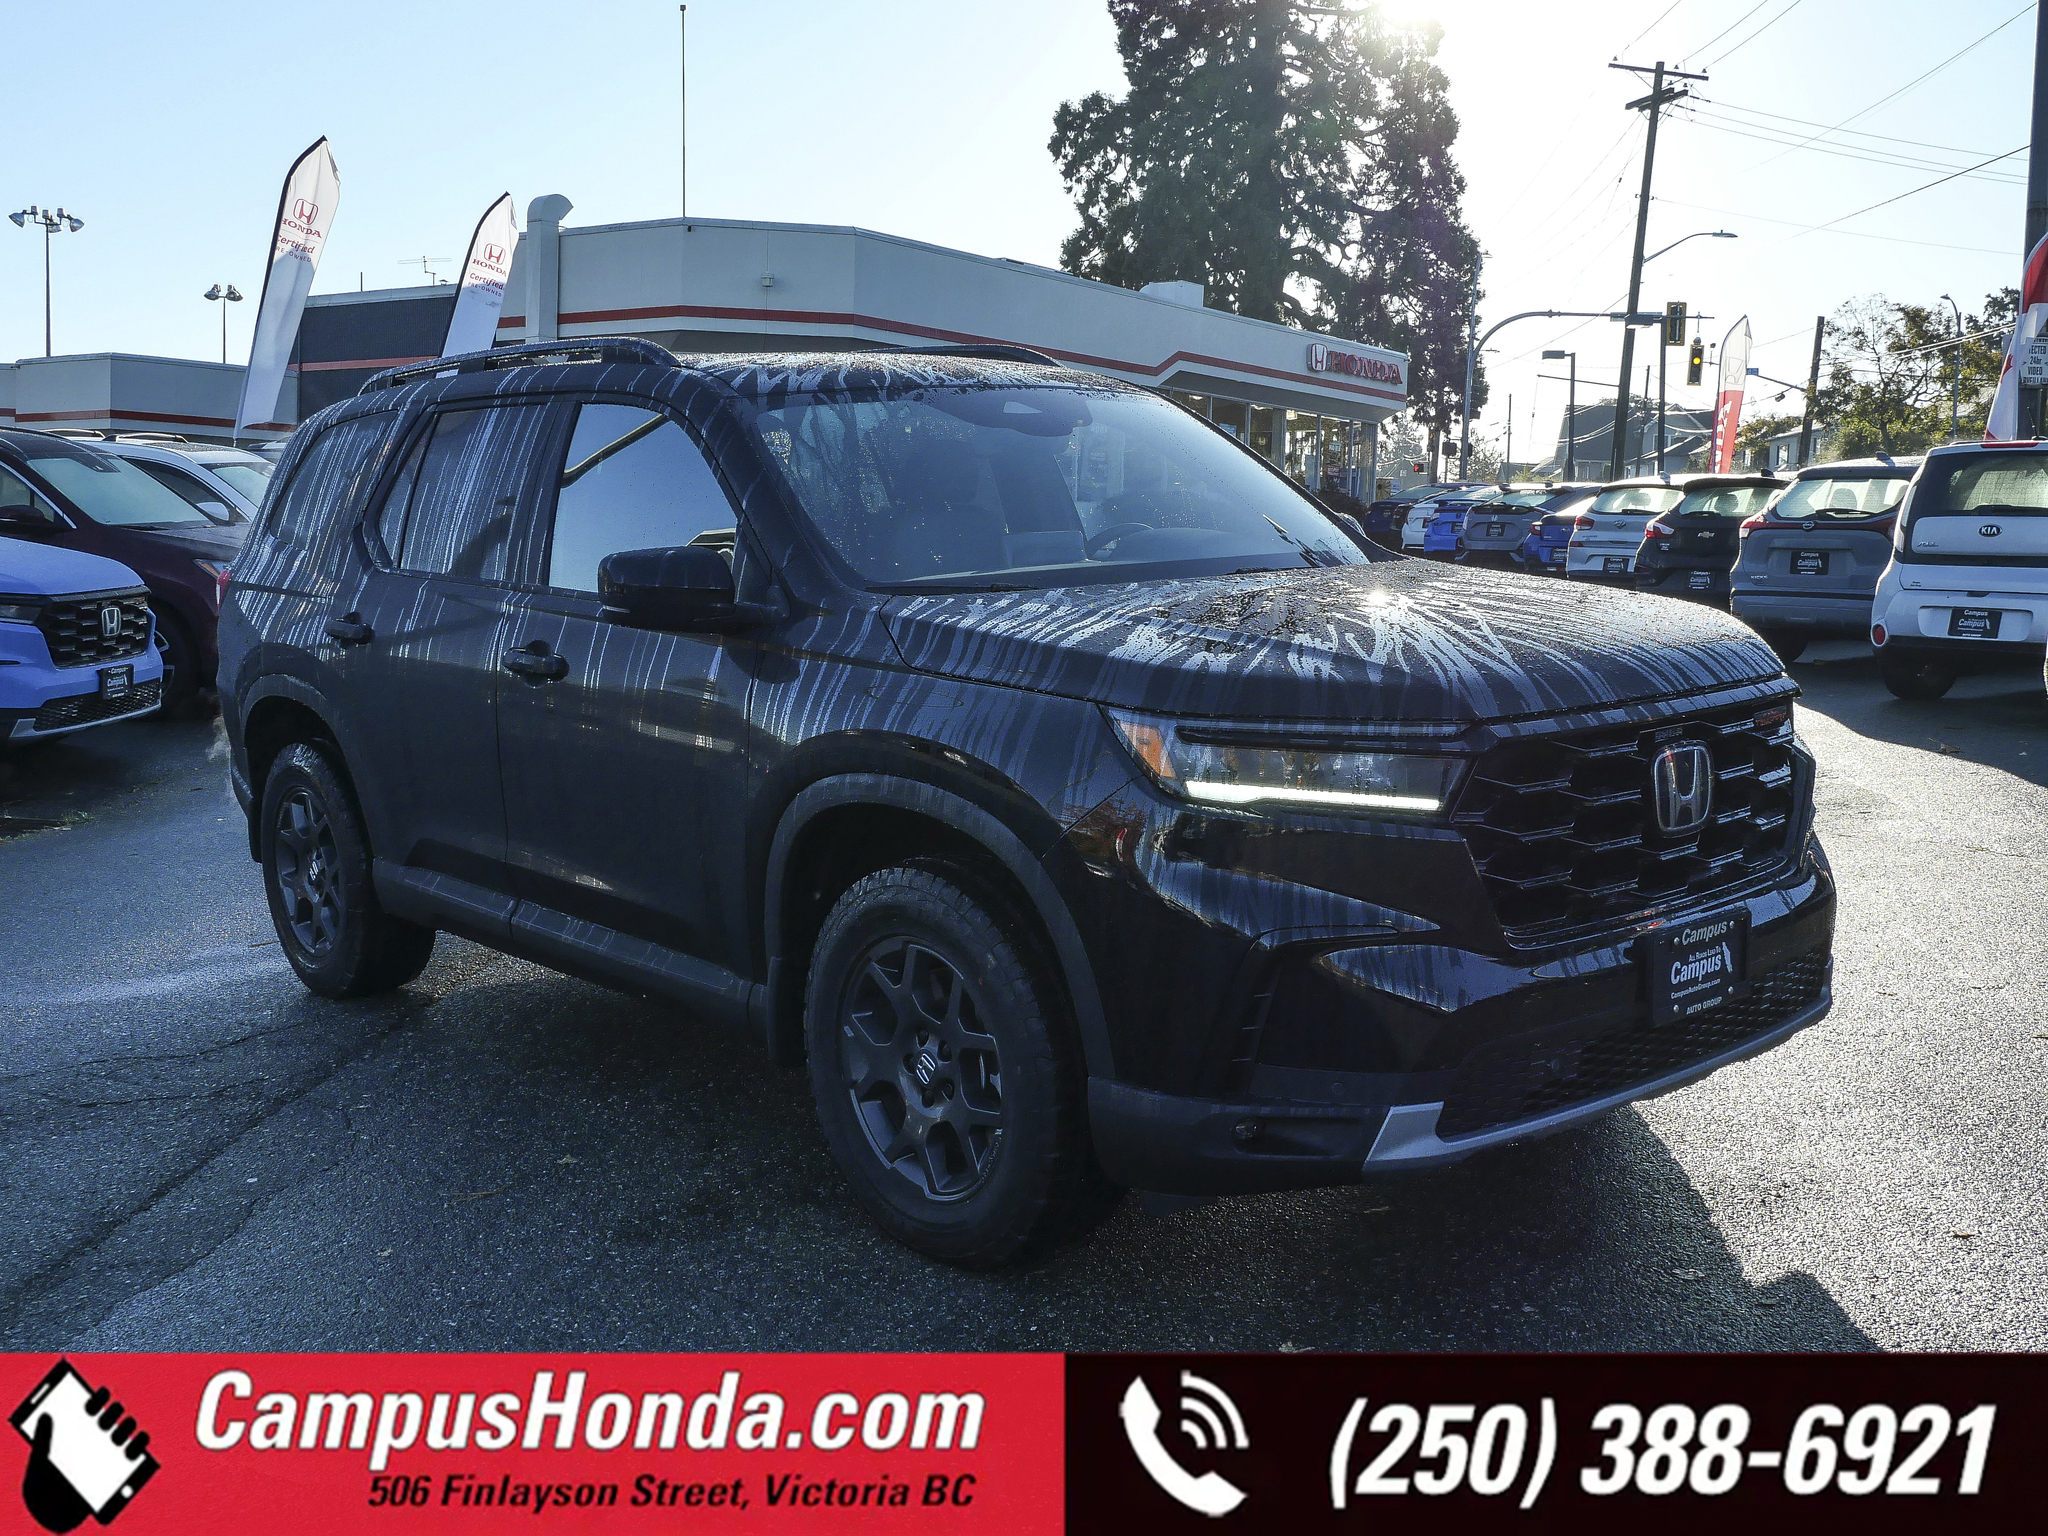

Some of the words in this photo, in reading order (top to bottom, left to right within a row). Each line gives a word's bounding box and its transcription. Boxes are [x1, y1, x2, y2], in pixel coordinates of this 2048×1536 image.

[276, 245, 312, 262] RE-OWNED
[278, 234, 316, 254] ertified
[472, 258, 508, 277] HONDA
[470, 272, 504, 290] Certified
[1329, 350, 1403, 384] HONDA
[2028, 366, 2043, 375] VIDEO
[1981, 526, 1998, 535] KIA
[1958, 618, 1985, 627] Campus
[1682, 921, 1727, 945] Campus
[1671, 954, 1721, 984] Campus
[1671, 978, 1721, 999] CampusAutoGroup.com
[1686, 1003, 1702, 1015] AUTO
[1702, 996, 1722, 1009] GROUP
